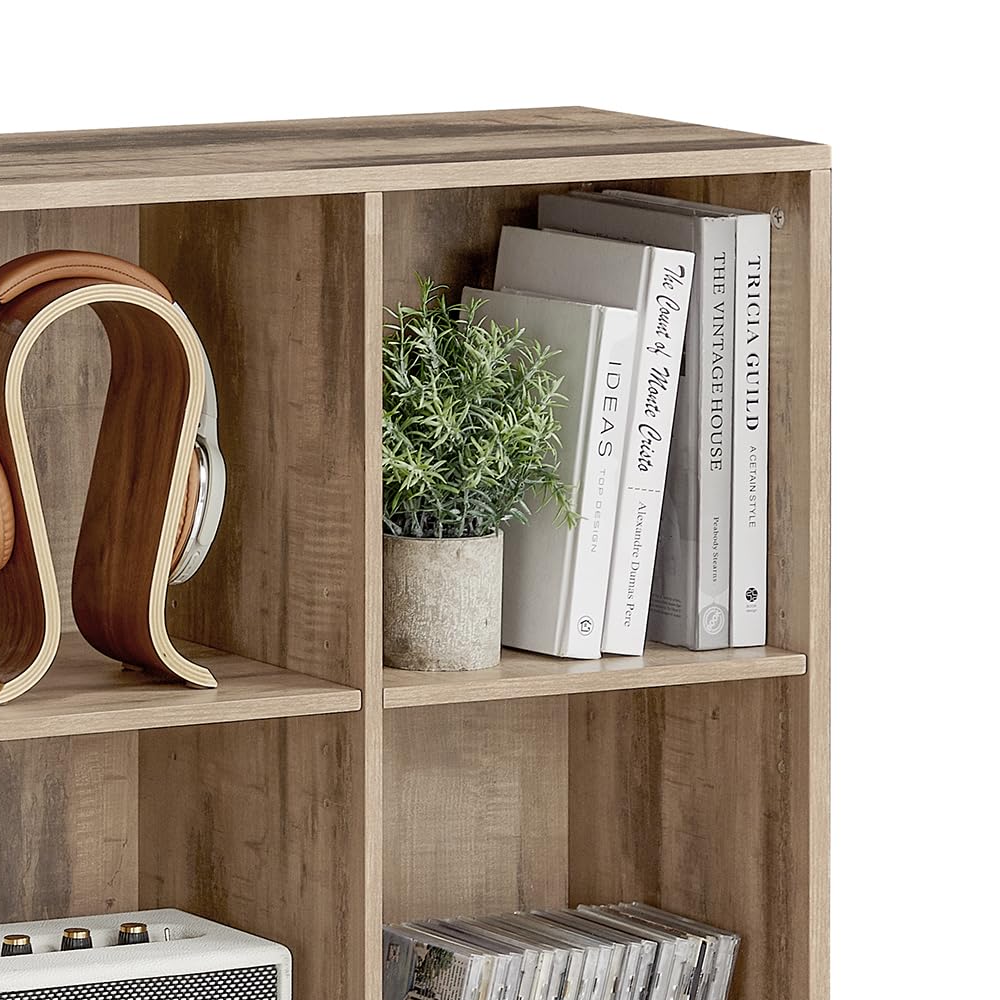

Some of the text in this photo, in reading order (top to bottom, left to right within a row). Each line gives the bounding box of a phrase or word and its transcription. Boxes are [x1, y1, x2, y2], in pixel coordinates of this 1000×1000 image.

[638, 264, 685, 472] The Count of Monte Cristo
[710, 252, 726, 471] THE VINTAGE HOUSE
[746, 256, 761, 431] TRICIA GUILD
[598, 361, 622, 458] IDEAS
[591, 469, 606, 553] TOP DESIGN
[624, 502, 647, 628] Alexandre Dumas Pere
[749, 495, 757, 528] STYLE
